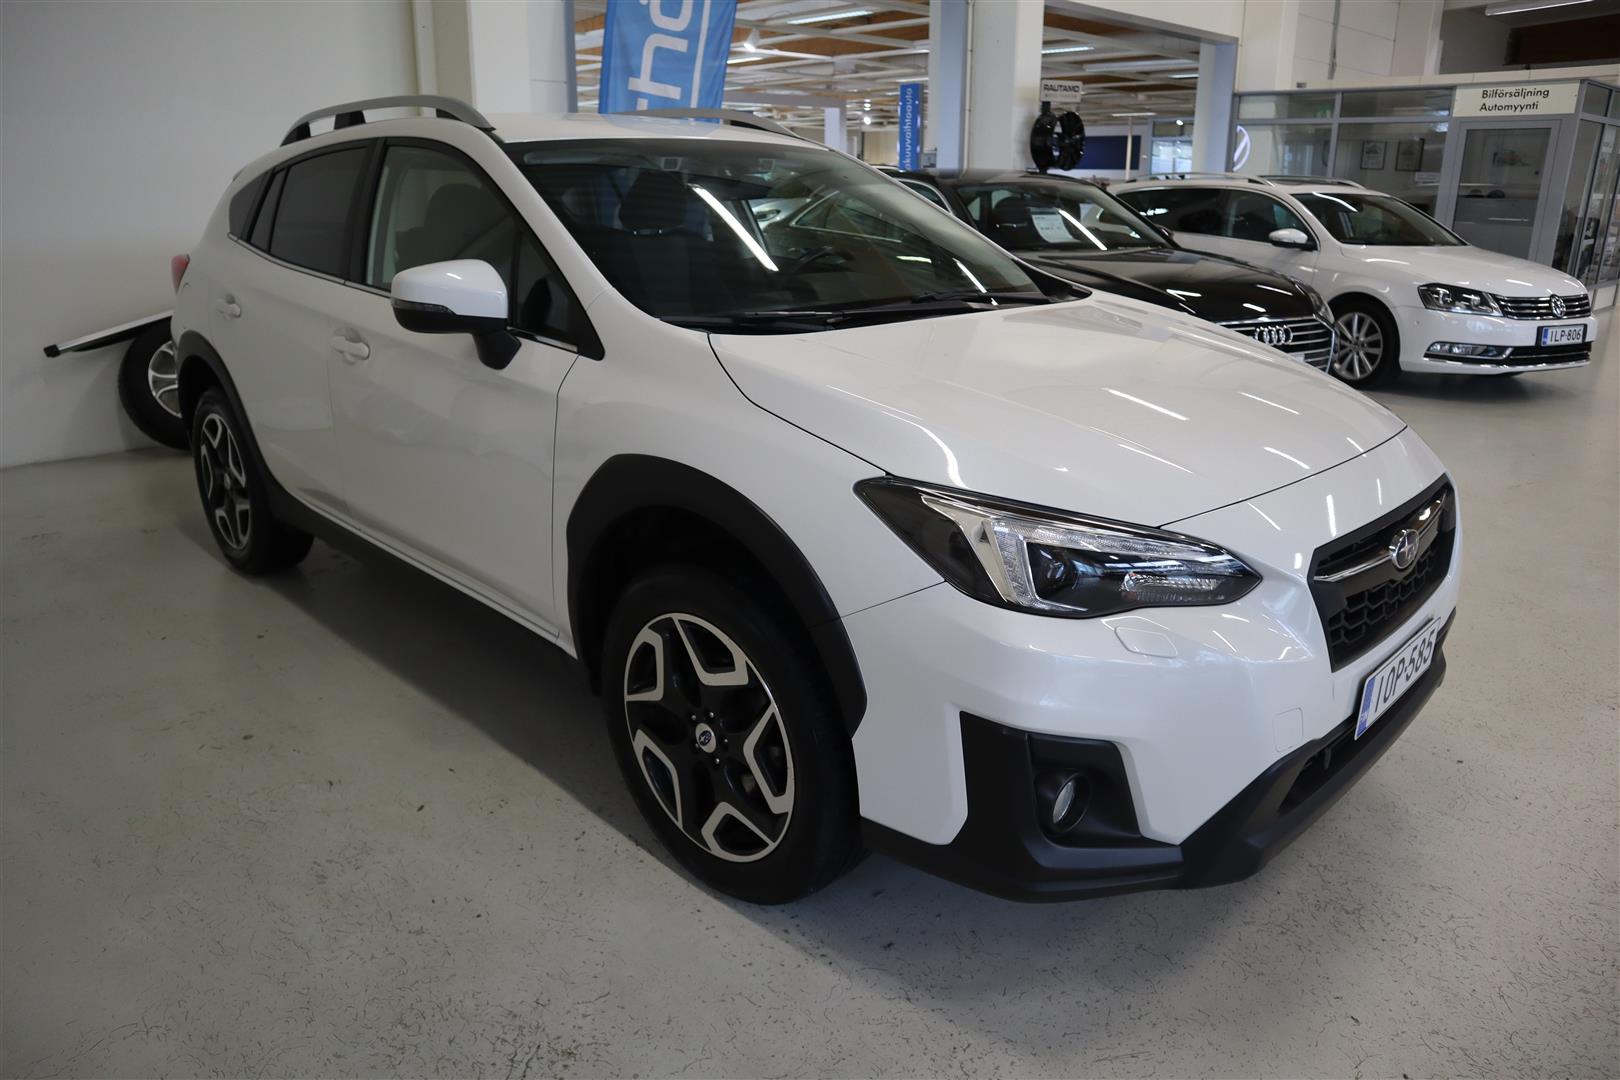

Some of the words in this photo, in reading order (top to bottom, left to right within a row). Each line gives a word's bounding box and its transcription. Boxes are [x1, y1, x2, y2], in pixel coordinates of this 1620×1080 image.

[1481, 88, 1549, 99] Bilförsäljning
[1479, 101, 1539, 112] Automyynti
[902, 88, 912, 170] akuuvaihtoauto
[1550, 329, 1581, 342] ILP-806
[1374, 628, 1436, 714] IOP-585
